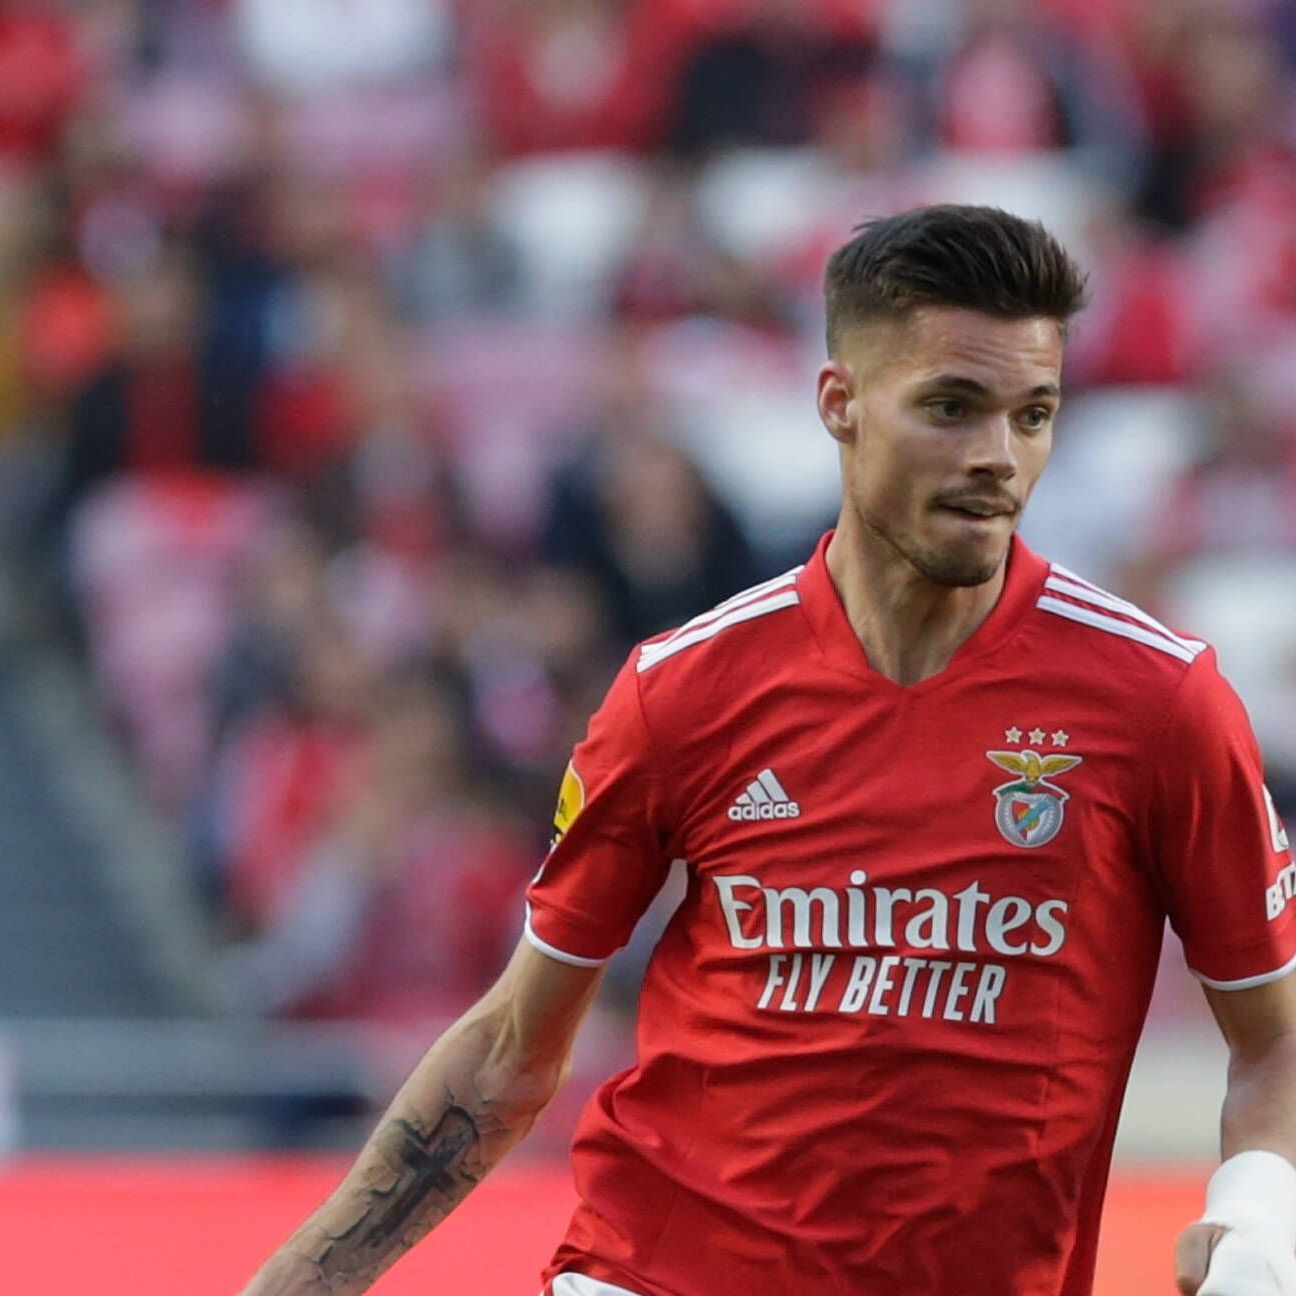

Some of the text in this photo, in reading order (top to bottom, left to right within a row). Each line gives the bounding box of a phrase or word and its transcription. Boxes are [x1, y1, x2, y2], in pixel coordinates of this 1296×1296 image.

[728, 801, 800, 821] adidas
[712, 869, 1068, 957] Emirates
[757, 953, 1006, 1024] FLY BETTER
